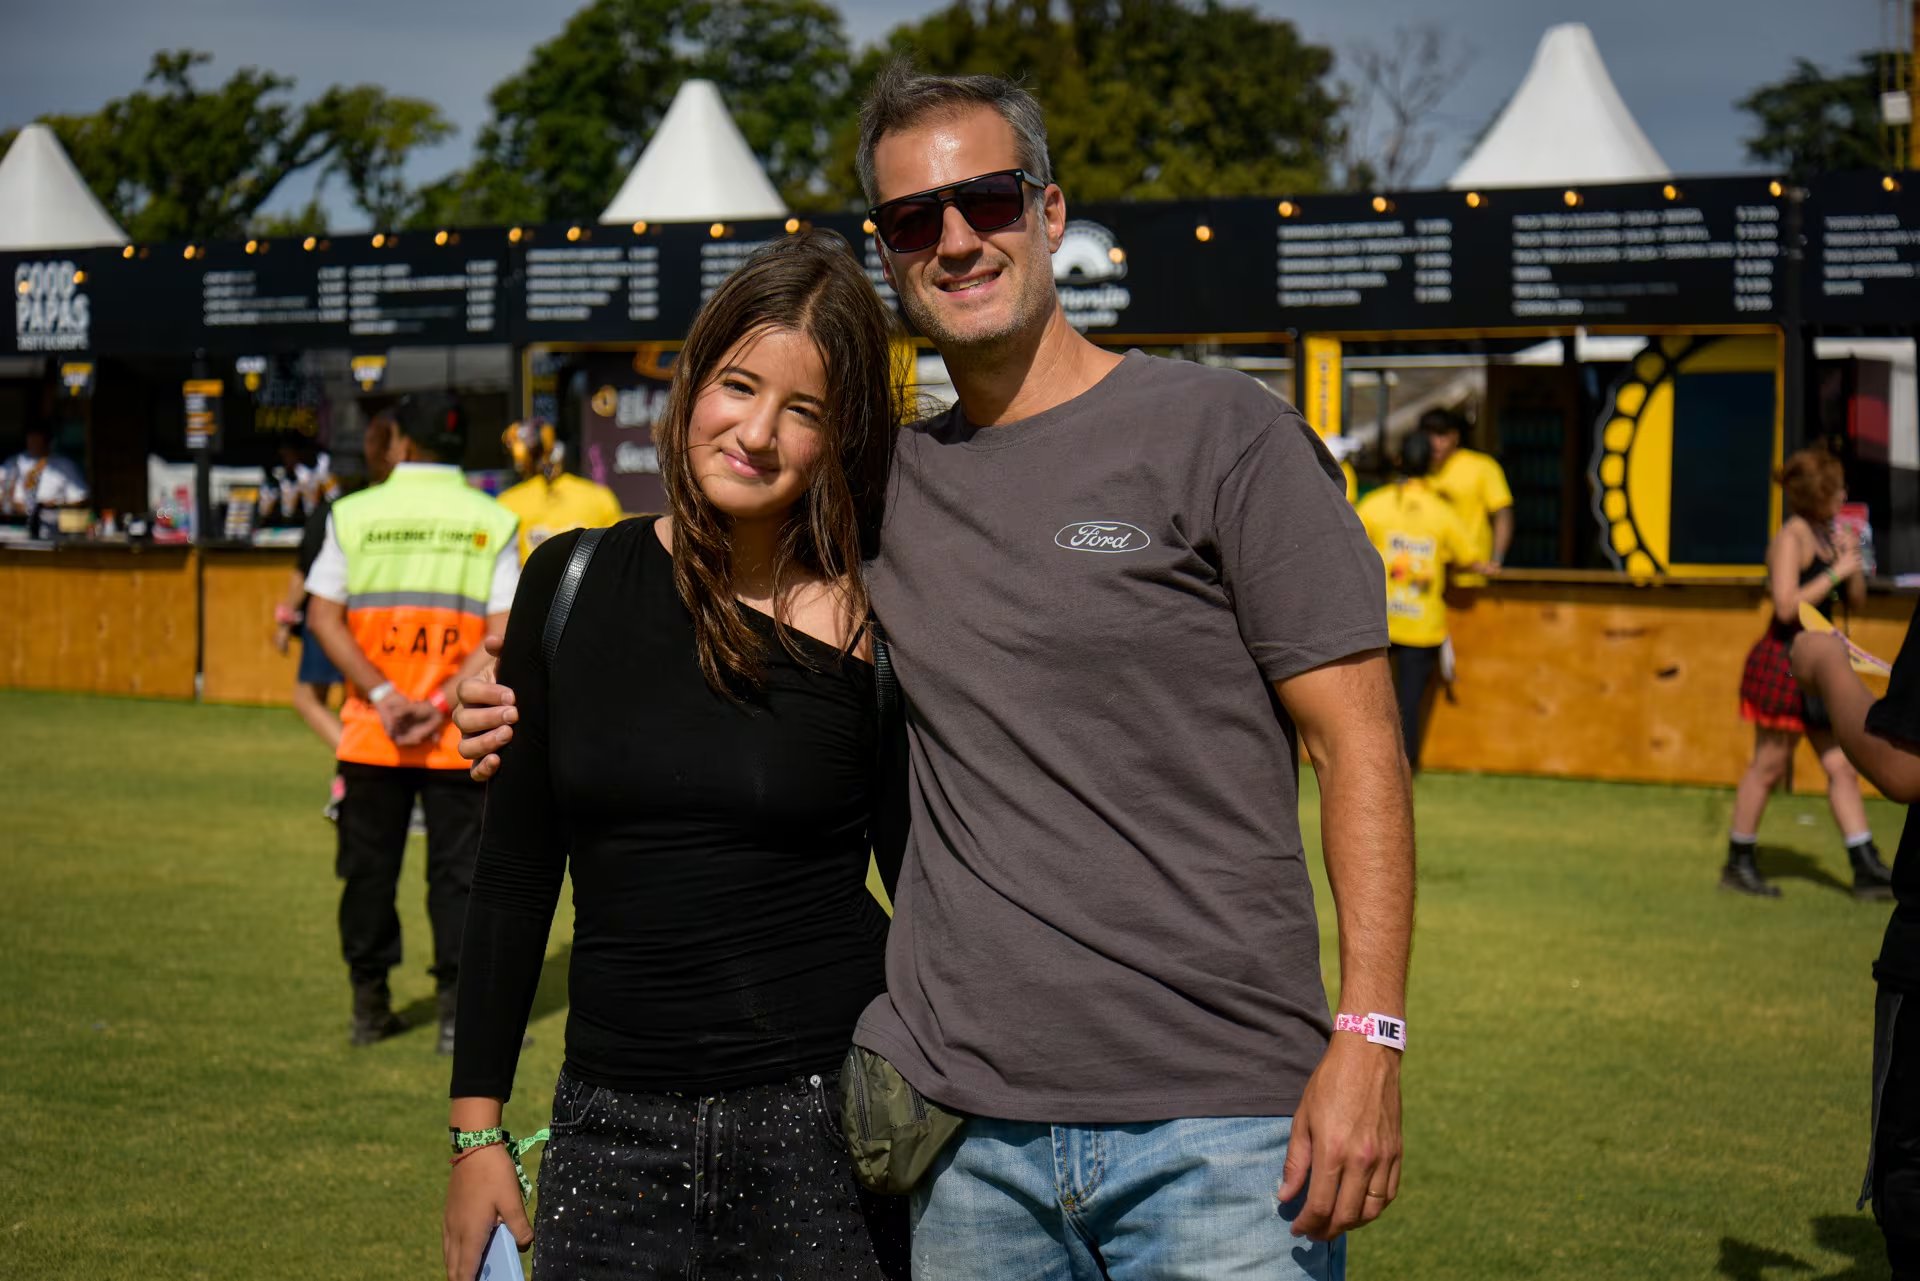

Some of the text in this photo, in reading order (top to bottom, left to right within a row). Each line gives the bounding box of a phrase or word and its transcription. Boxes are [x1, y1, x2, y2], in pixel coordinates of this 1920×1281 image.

[15, 294, 90, 335] PAPAS
[1070, 524, 1132, 549] Ford
[1378, 1019, 1401, 1040] VIE
